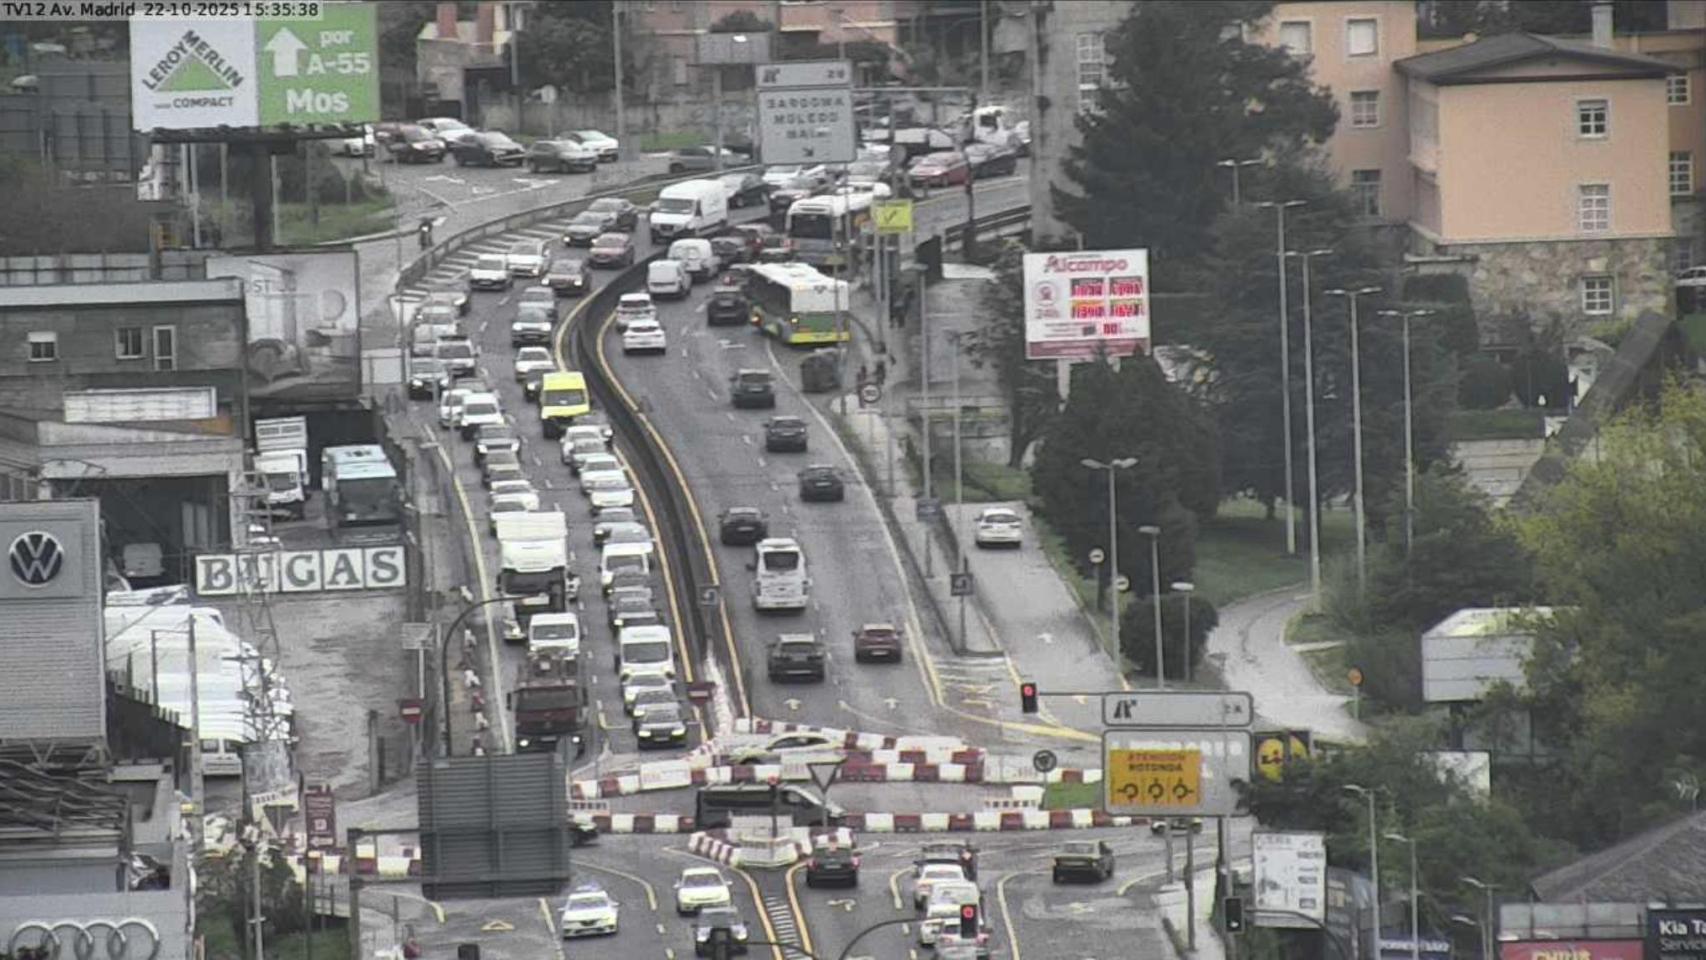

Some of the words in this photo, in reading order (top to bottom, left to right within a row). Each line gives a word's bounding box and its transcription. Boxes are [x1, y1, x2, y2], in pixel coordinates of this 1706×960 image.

[319, 31, 353, 48] por
[142, 42, 192, 90] LEROY
[182, 30, 245, 88] MERLIN
[306, 53, 371, 74] A-55
[173, 97, 234, 109] COMPACT
[286, 88, 349, 114] Mos
[1044, 255, 1128, 273] Alcampo
[199, 550, 400, 592] BUGAS
[1659, 920, 1688, 935] Kia
